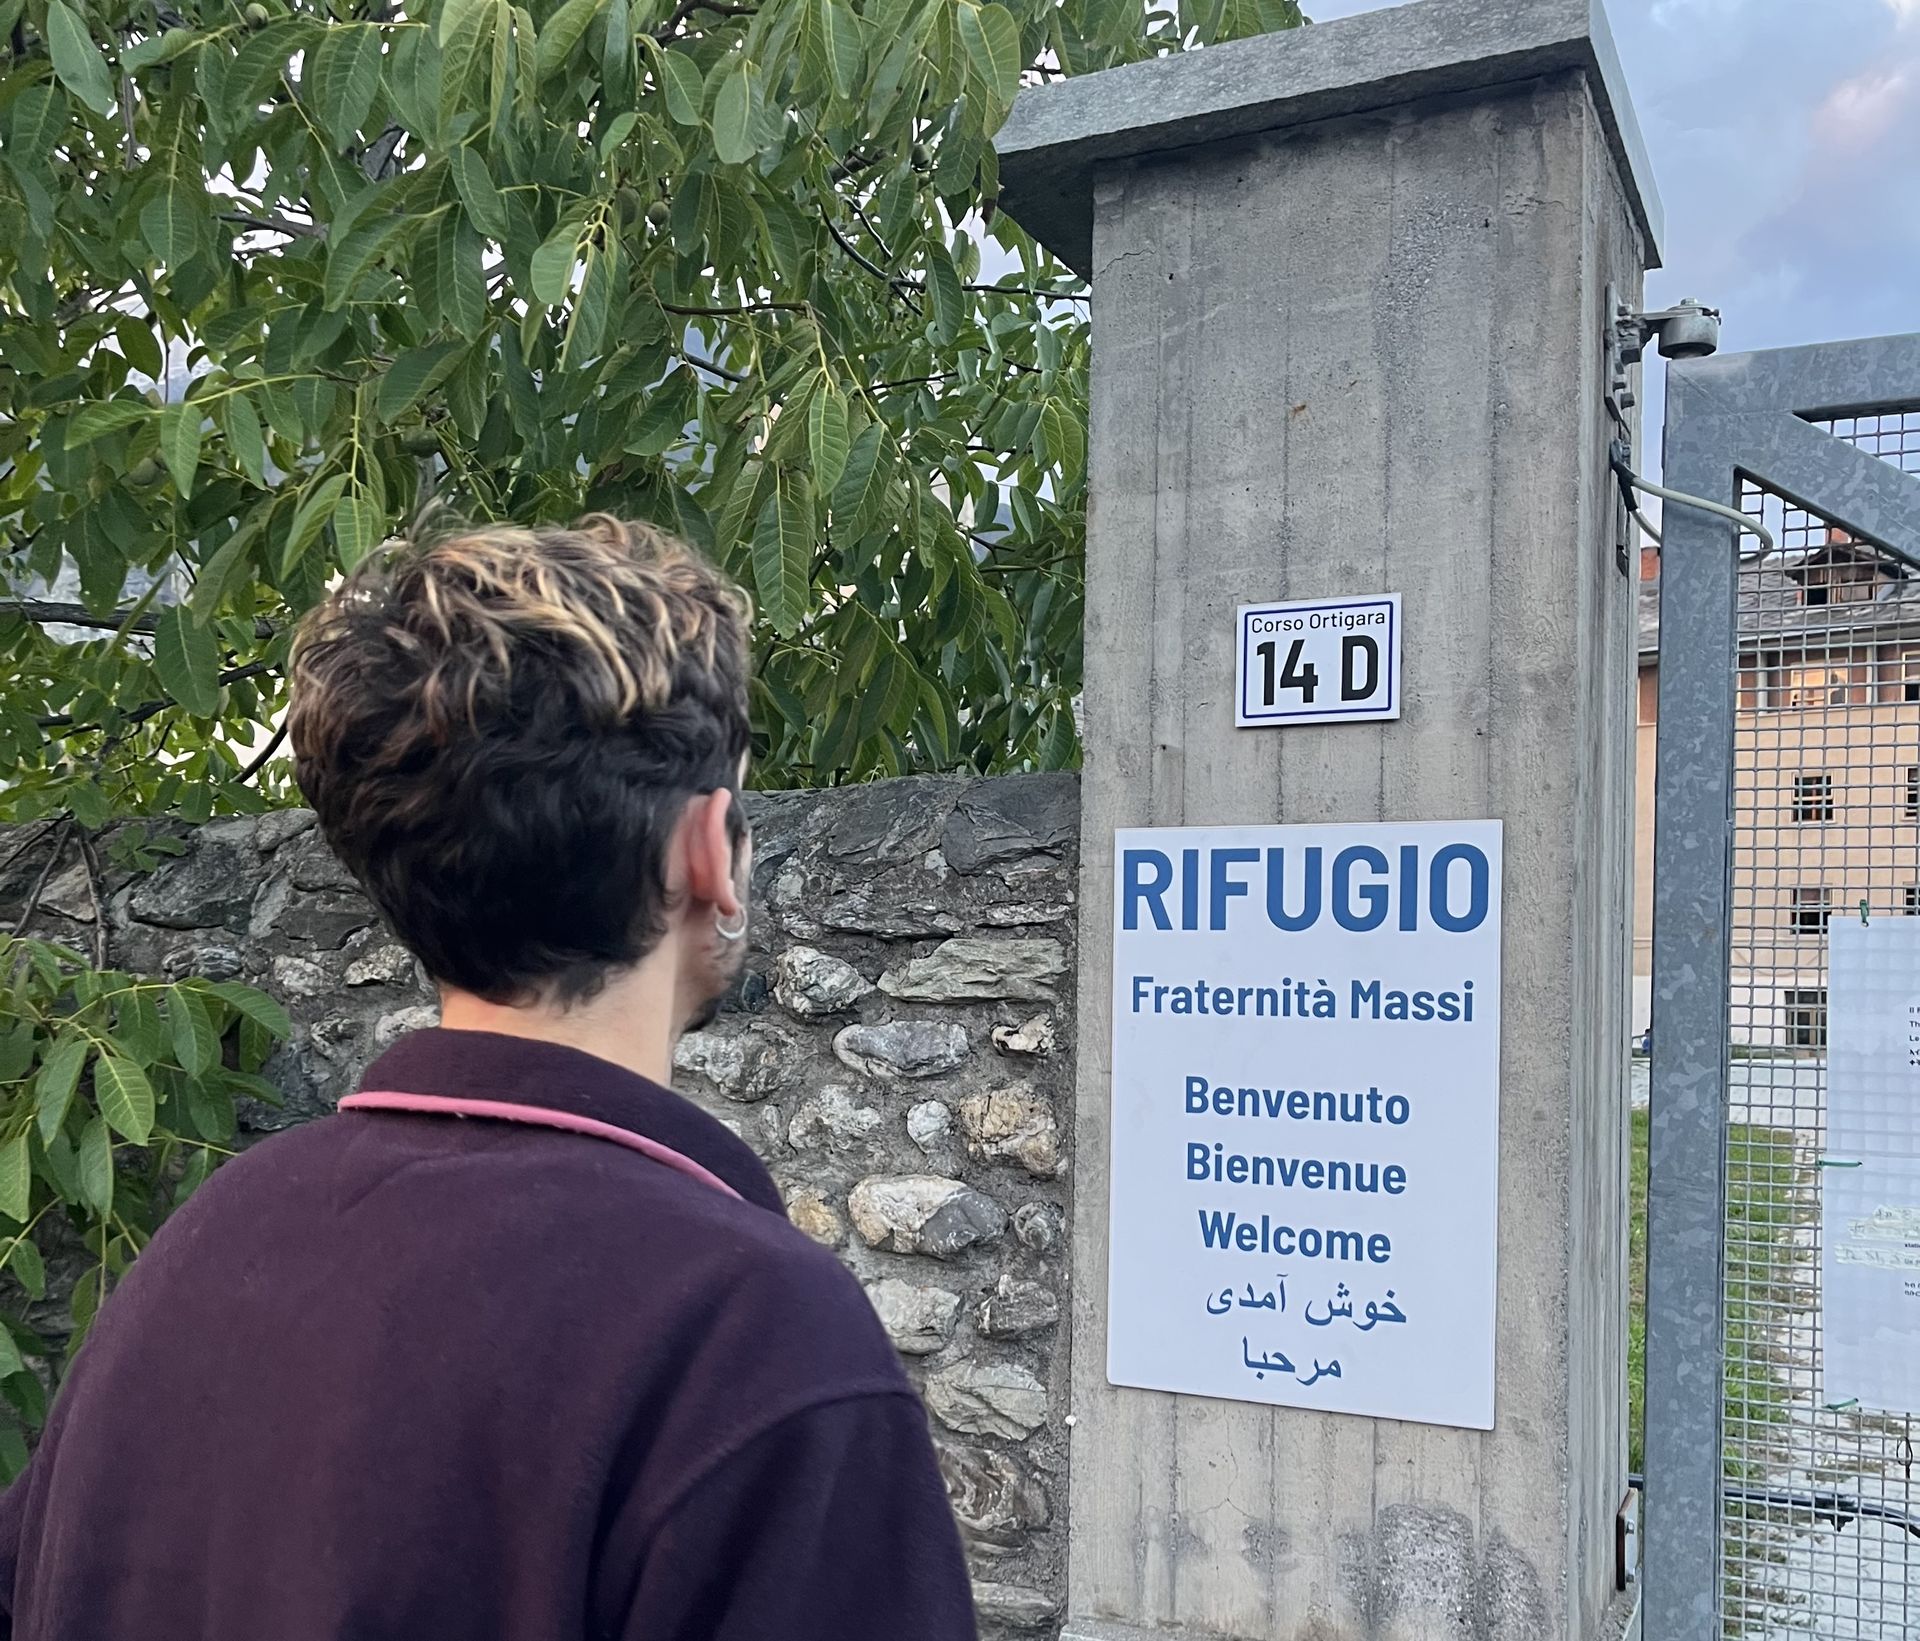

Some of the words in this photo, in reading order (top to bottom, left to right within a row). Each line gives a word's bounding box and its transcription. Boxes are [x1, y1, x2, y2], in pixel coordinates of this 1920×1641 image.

[1252, 618, 1304, 633] Corso
[1309, 612, 1385, 630] Ortigara
[1256, 639, 1318, 706] 14
[1341, 635, 1378, 701] D
[1123, 844, 1489, 932] RIFUGIO
[1132, 976, 1336, 1019] Fraternità
[1351, 980, 1474, 1021] Massi
[1186, 1076, 1410, 1124] Benvenuto
[1187, 1143, 1407, 1194] Bienvenue
[1199, 1210, 1391, 1263] Welcome
[1206, 1274, 1288, 1315] آمدی
[1305, 1283, 1407, 1331] خوش
[1243, 1336, 1342, 1386] مرحبا
